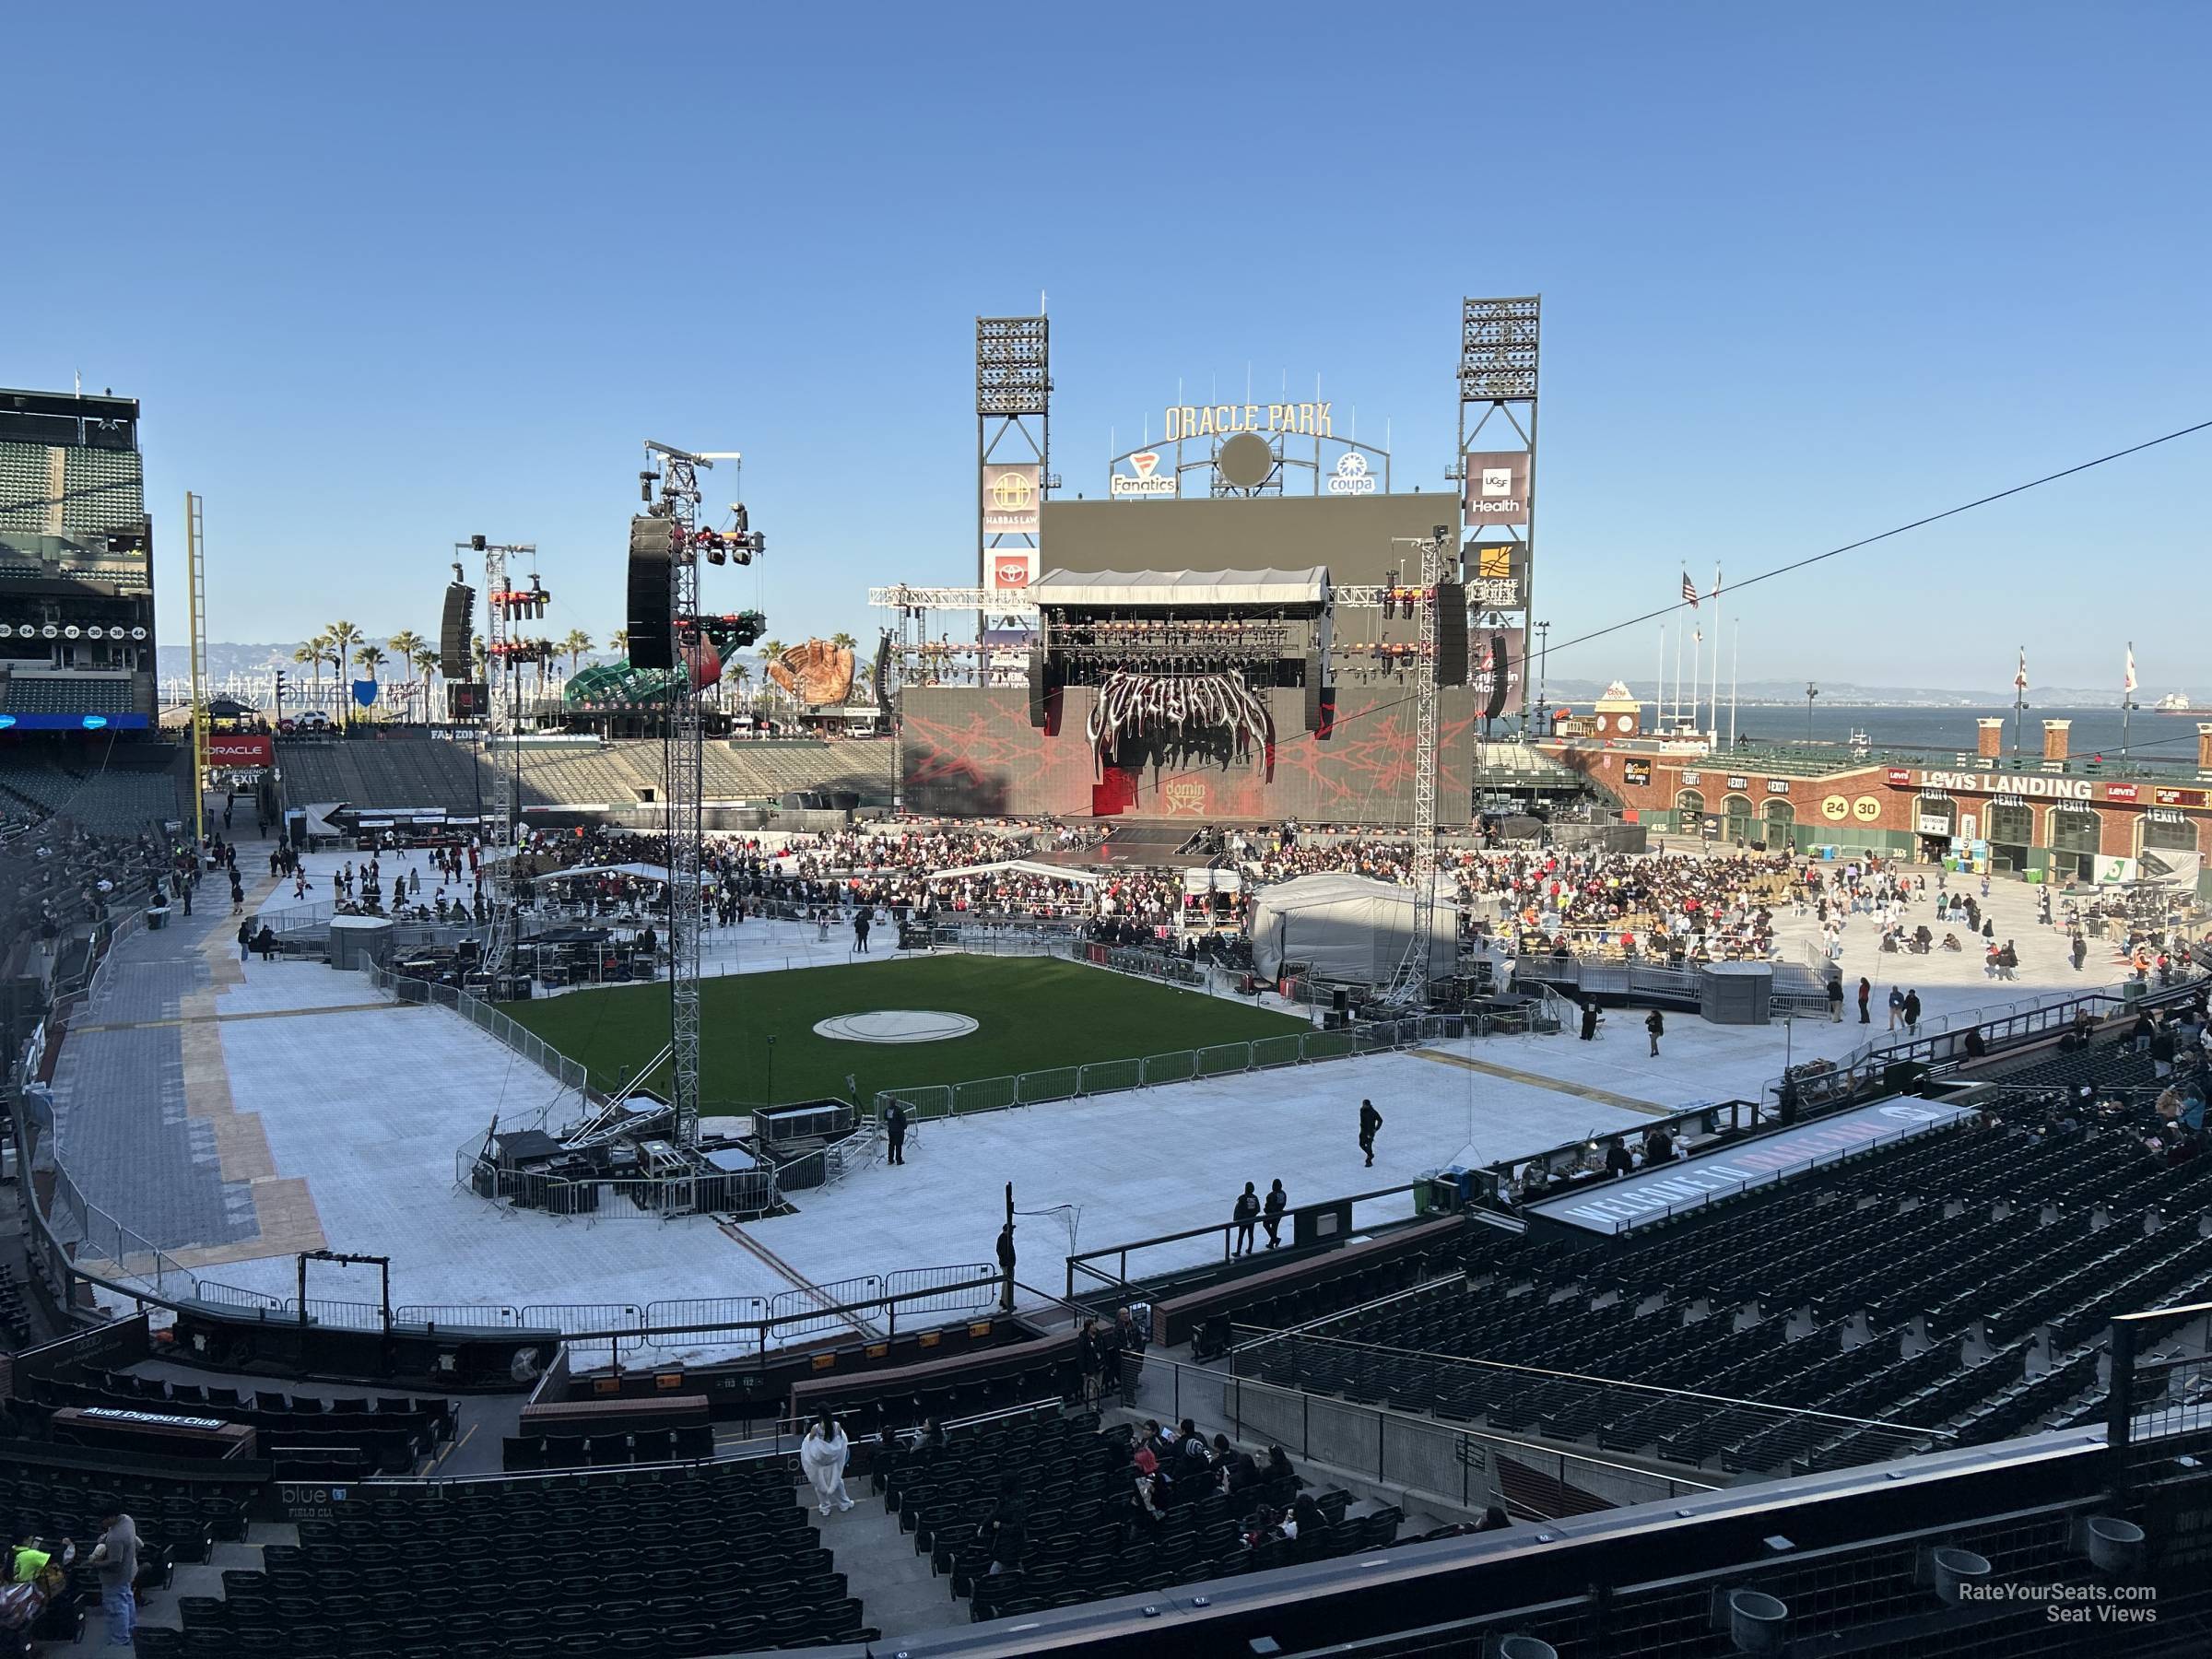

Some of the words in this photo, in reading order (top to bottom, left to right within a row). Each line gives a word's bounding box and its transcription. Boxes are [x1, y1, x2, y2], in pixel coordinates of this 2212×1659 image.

[1165, 404, 1259, 442] ORACLE
[1267, 402, 1333, 438] PARK
[1113, 477, 1175, 492] Fanatics
[1330, 477, 1373, 493] coupa
[1486, 477, 1509, 488] UCSF
[1472, 499, 1520, 513] Health
[985, 516, 1019, 525] HABBAS
[1019, 515, 1039, 525] LAW
[1466, 671, 1519, 684] Bnjin
[202, 747, 263, 755] ORACLE
[232, 774, 260, 784] EXIT
[1685, 776, 1697, 785] EXIT
[1731, 777, 1744, 789] EXIT
[1771, 781, 1785, 793] EXIT
[1983, 773, 2092, 800] LANDING
[1924, 788, 1944, 800] EXIT
[1998, 794, 2019, 806] EXIT
[1827, 802, 1845, 813] 24
[1858, 803, 1876, 815] 30
[2061, 800, 2085, 813] EXIT
[2153, 808, 2179, 824] EXIT
[1651, 823, 1667, 831] 415
[1564, 1175, 1720, 1224] WELCOME
[1693, 1164, 1753, 1187] TO
[85, 1406, 124, 1417] Audi
[122, 1411, 182, 1423] Dugout
[184, 1417, 220, 1427] Club
[281, 1485, 326, 1503] blue
